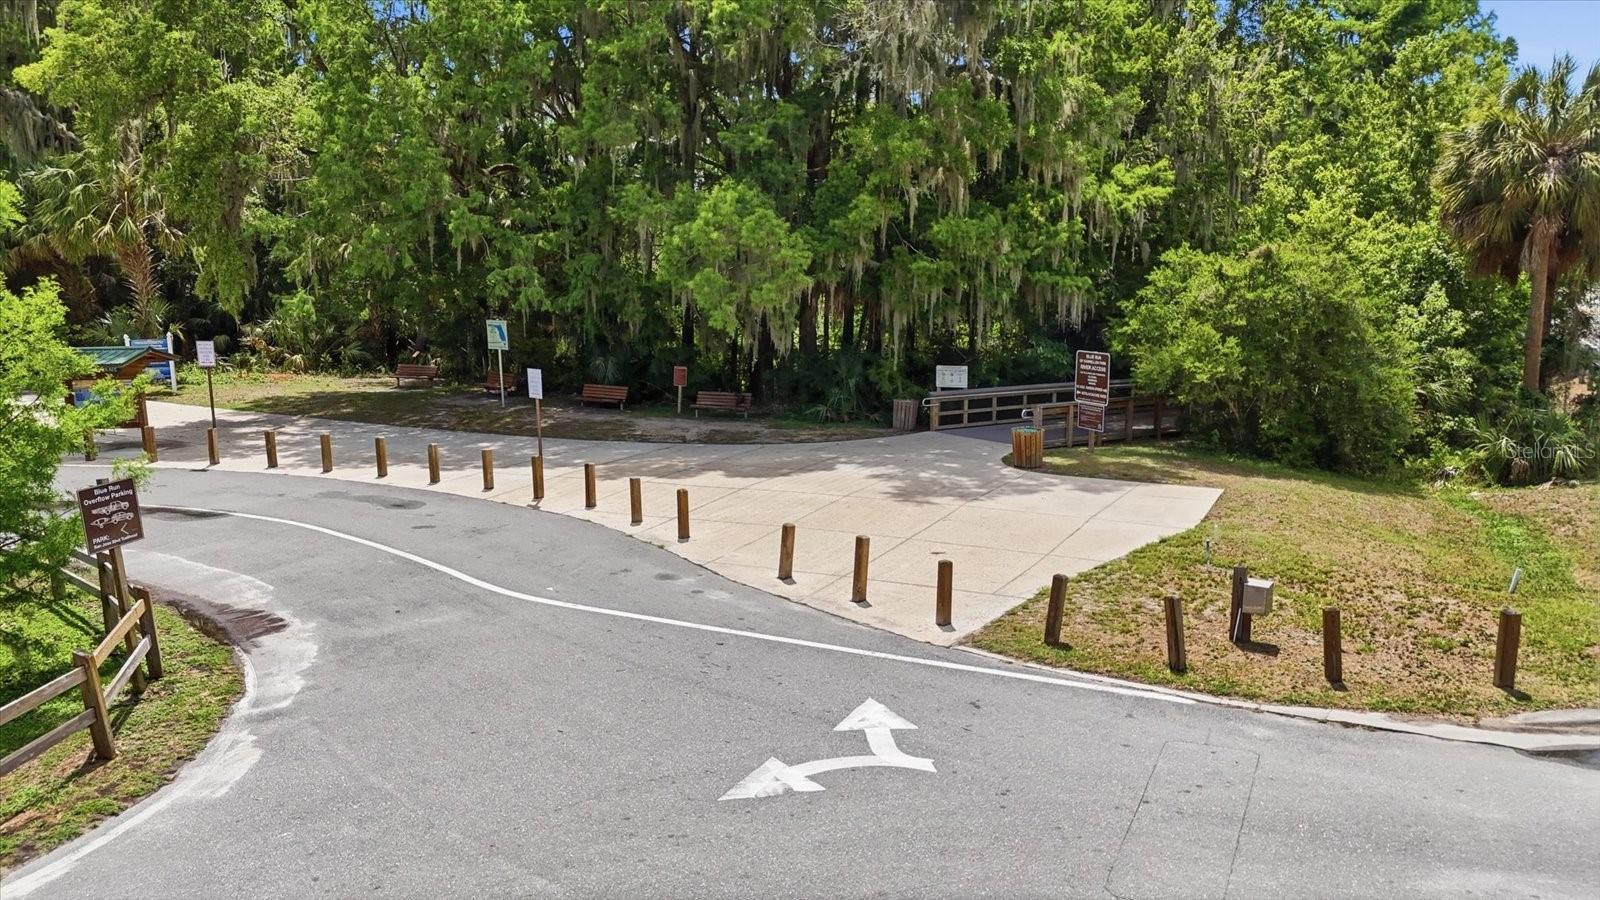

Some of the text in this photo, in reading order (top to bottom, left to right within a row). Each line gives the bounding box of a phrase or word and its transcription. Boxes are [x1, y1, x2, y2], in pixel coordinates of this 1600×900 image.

[83, 489, 133, 506] Overflow Parking
[93, 488, 108, 496] Blue
